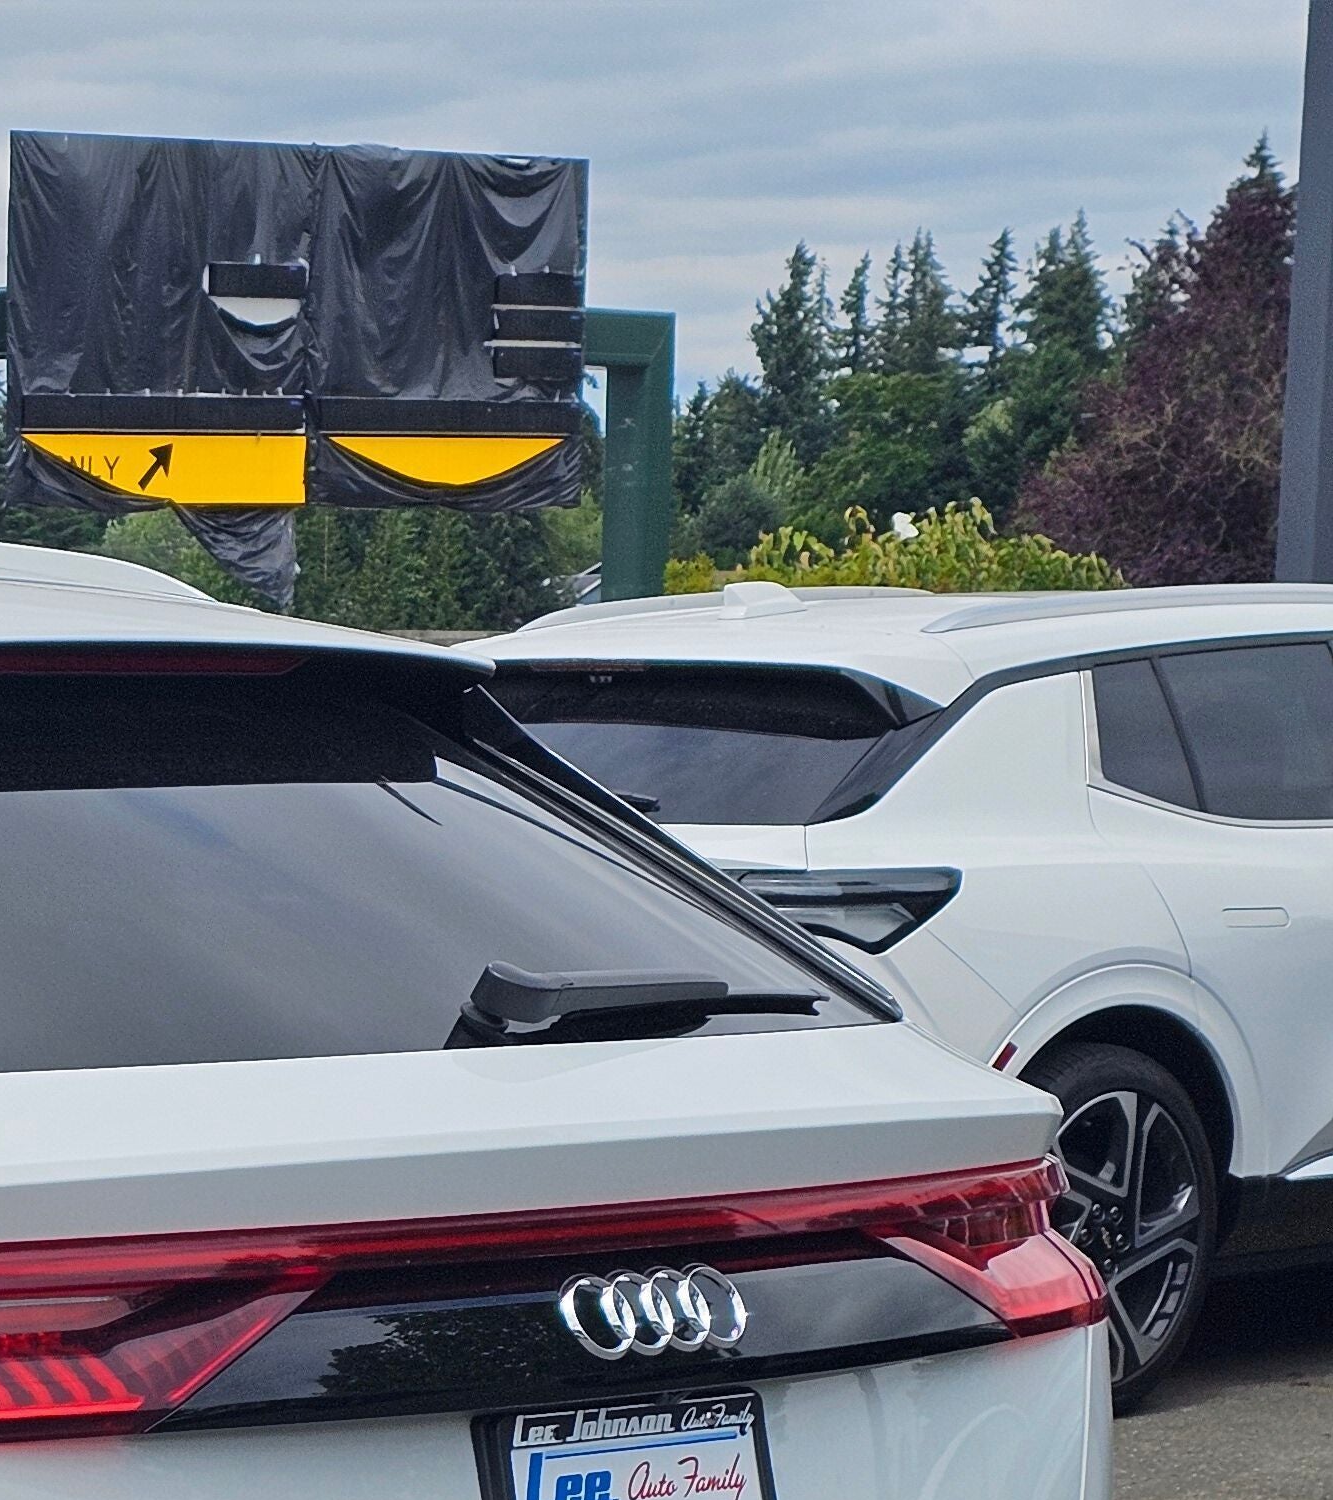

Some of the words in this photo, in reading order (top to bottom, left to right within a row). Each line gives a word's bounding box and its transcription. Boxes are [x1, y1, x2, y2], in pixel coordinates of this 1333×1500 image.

[58, 455, 120, 480] NLY
[566, 1407, 675, 1442] Johnson
[681, 1406, 709, 1431] Aut
[628, 1461, 678, 1500] Auto
